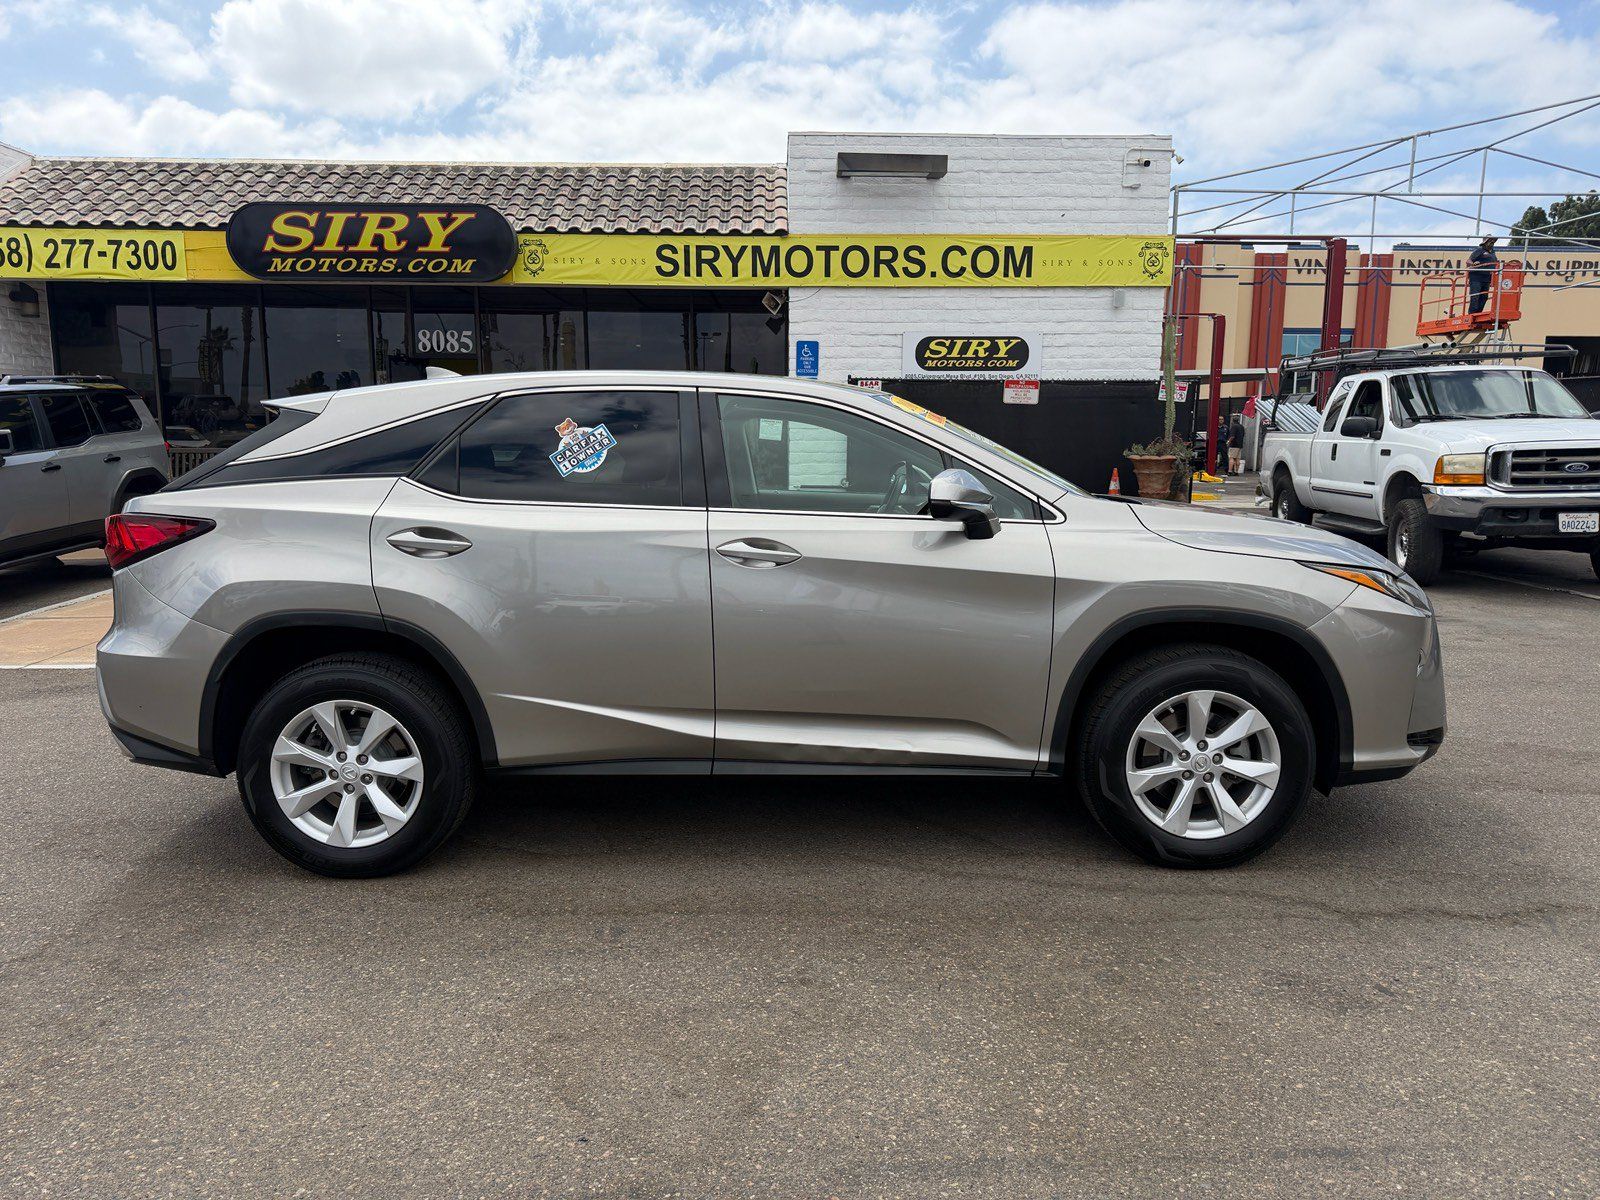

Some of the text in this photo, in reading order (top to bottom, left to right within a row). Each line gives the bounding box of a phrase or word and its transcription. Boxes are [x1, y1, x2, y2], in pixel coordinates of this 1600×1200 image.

[262, 211, 478, 254] SIRY
[43, 238, 178, 271] 277-7300
[553, 256, 648, 266] SIRY & SONS
[654, 243, 1034, 279] SIRYMOTORS.COM
[1041, 259, 1134, 268] SIRY & SONS
[267, 257, 478, 274] MOTORS.COM
[417, 328, 474, 355] 8085
[923, 338, 1021, 358] SIRY
[924, 359, 1020, 368] MOTORS.COM
[556, 431, 606, 462] CARFAX
[1561, 520, 1597, 530] 8A02243
